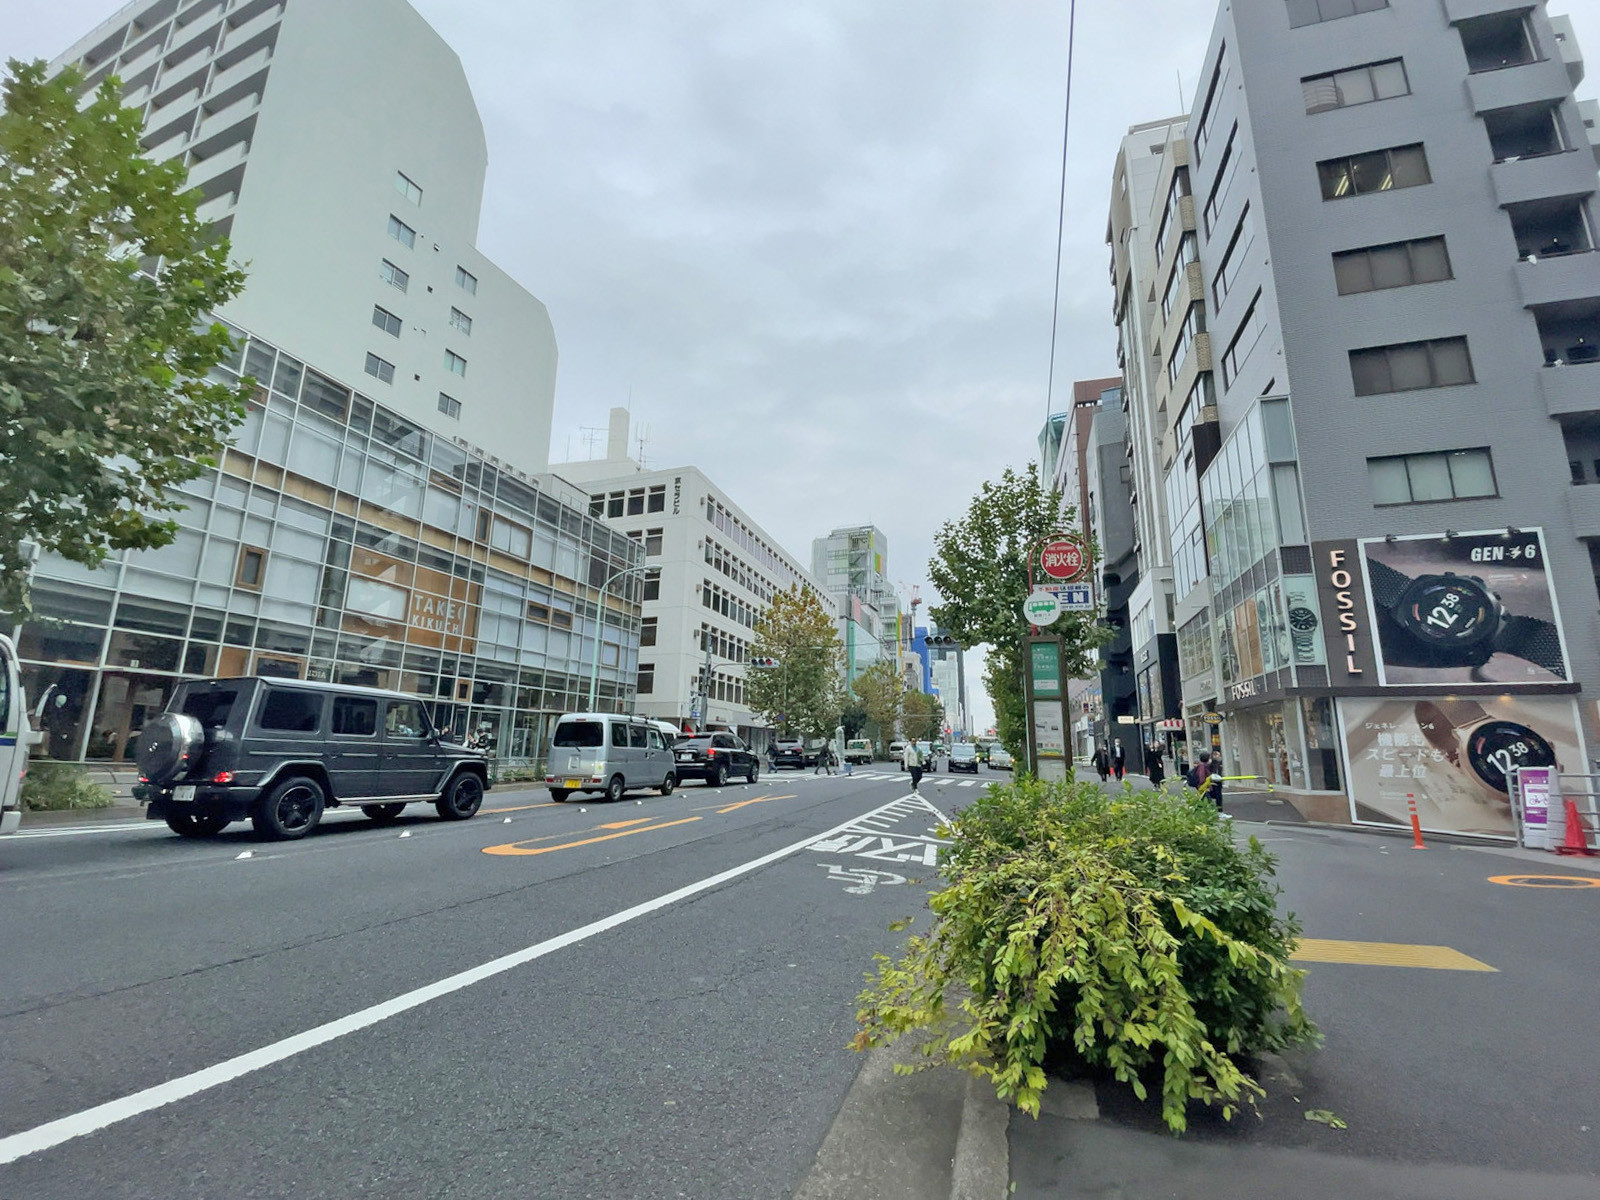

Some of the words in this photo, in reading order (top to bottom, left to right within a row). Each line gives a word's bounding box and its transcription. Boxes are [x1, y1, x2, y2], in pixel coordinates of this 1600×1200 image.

[1044, 552, 1079, 568] 消火栓
[1470, 546, 1505, 562] GEN
[1524, 544, 1536, 559] 6
[1057, 591, 1085, 604] EN
[1440, 592, 1460, 608] 38
[1329, 549, 1363, 674] FOSSIL
[1427, 606, 1459, 629] 12
[412, 614, 460, 635] KIKUCH
[1231, 681, 1257, 701] FOSSIL
[1365, 722, 1435, 731] ジェネレーン6
[1377, 732, 1424, 746] 機能も
[1365, 748, 1444, 762] スピードも
[1486, 749, 1520, 775] 12
[1508, 741, 1529, 757] 38
[1378, 763, 1427, 778] 最上位
